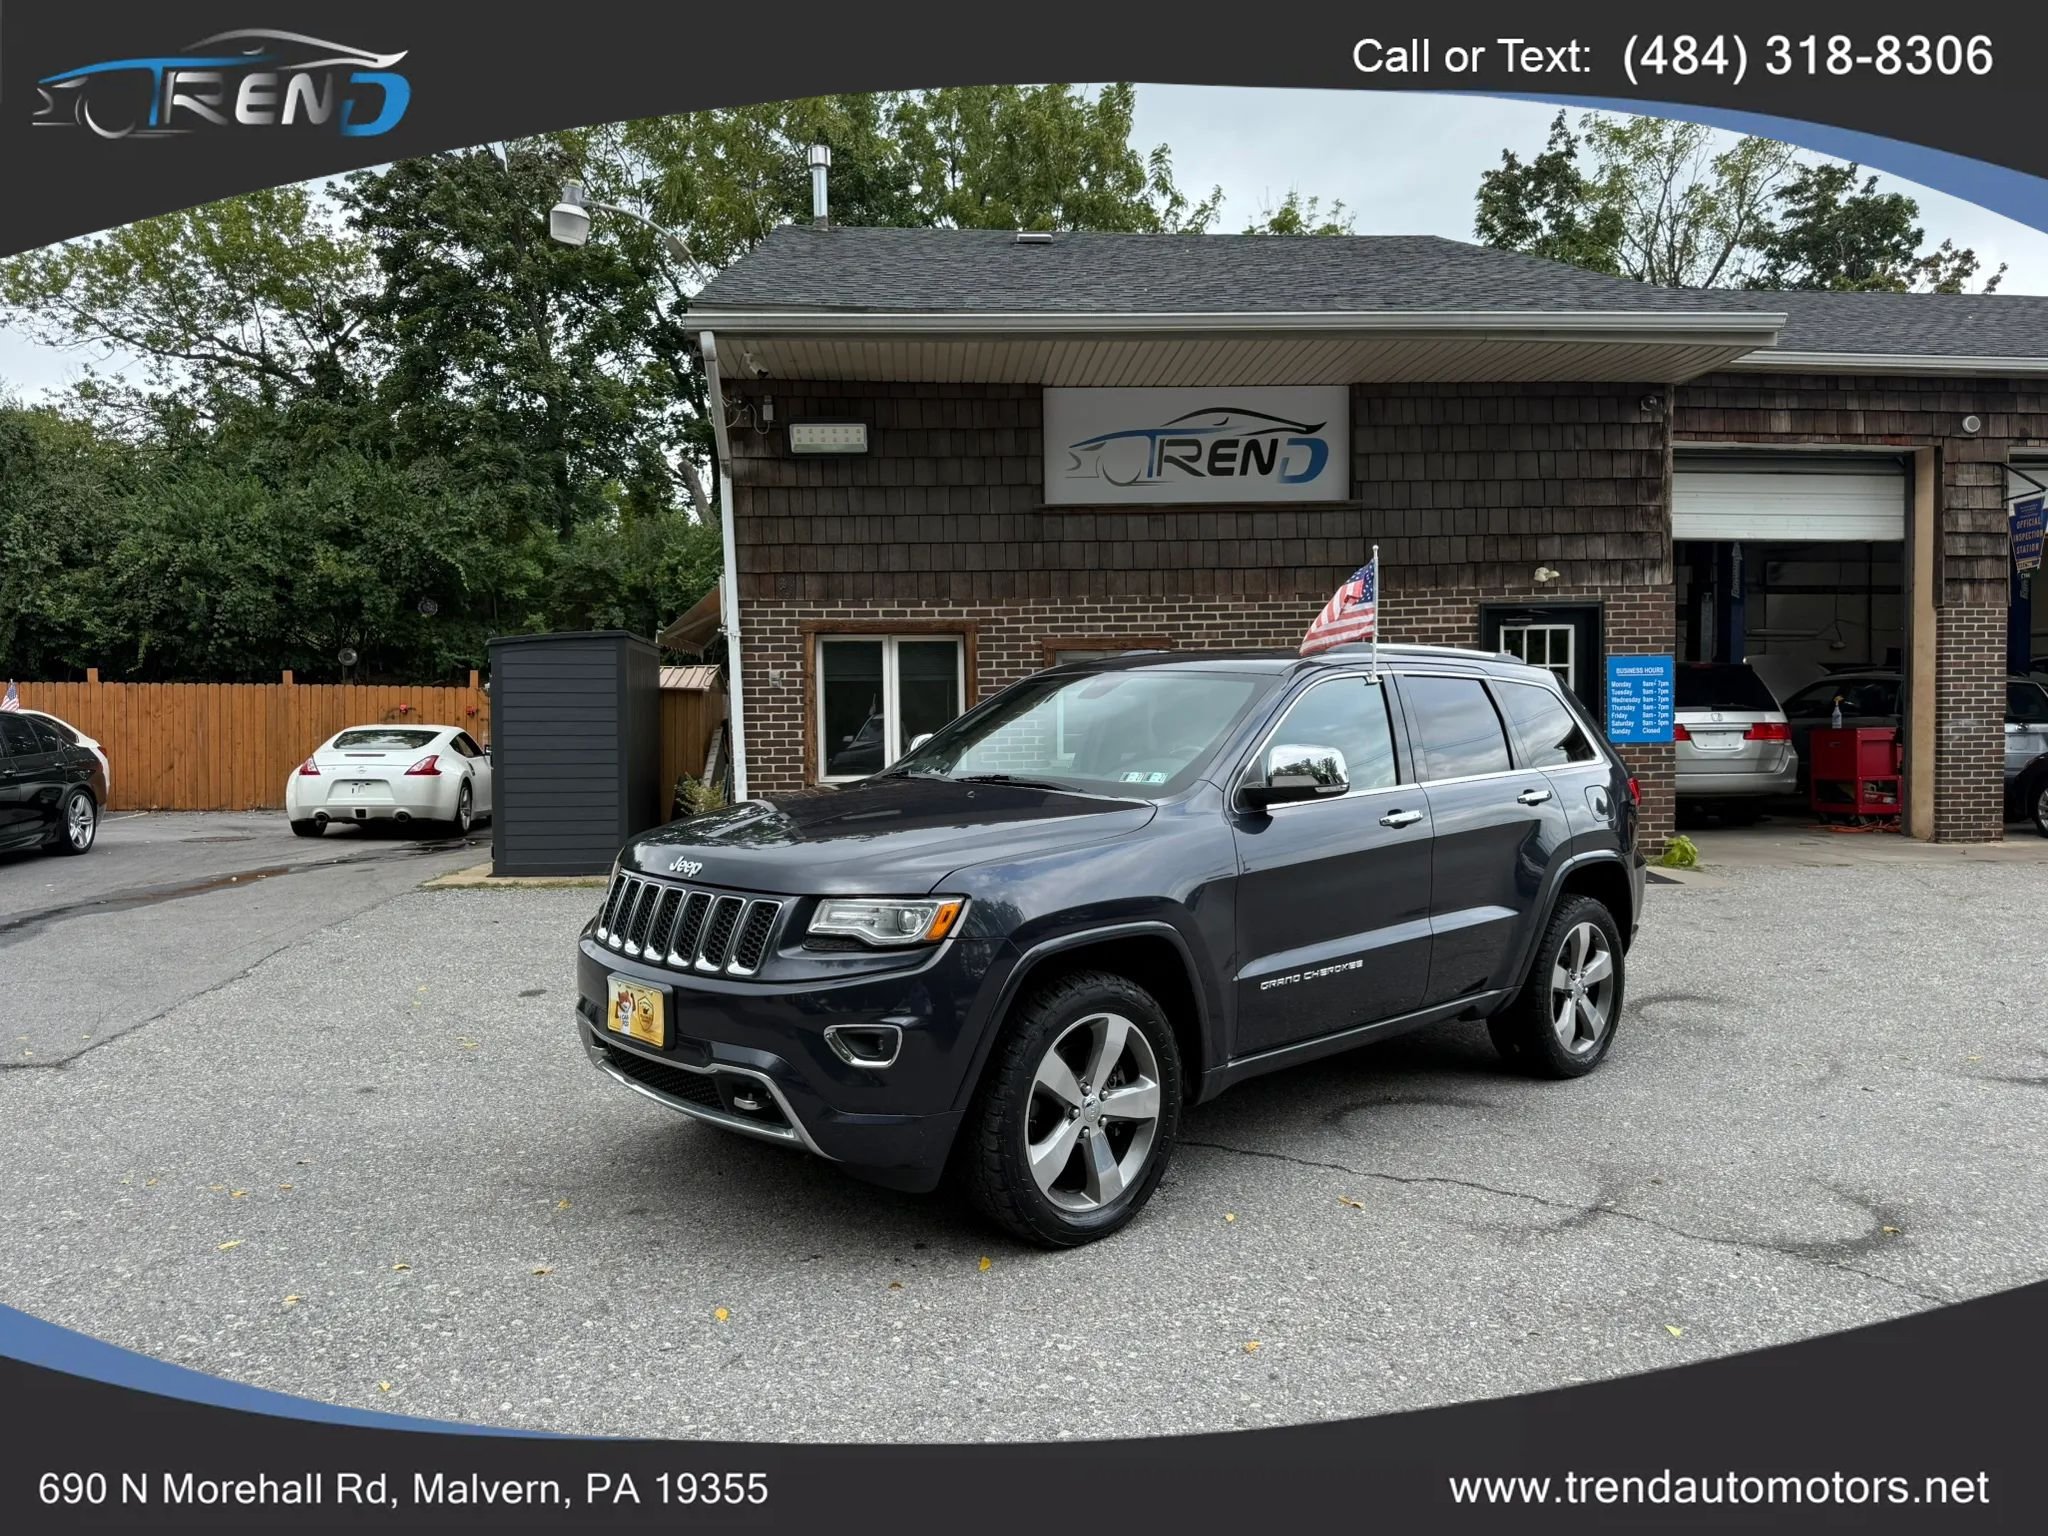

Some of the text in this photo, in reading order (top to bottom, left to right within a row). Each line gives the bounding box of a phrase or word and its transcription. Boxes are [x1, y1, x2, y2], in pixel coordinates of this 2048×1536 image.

[1105, 427, 1329, 484] TREND
[2016, 543, 2040, 554] STATION
[669, 856, 702, 878] Jeep
[1260, 960, 1363, 990] GRAND CHEROKEE
